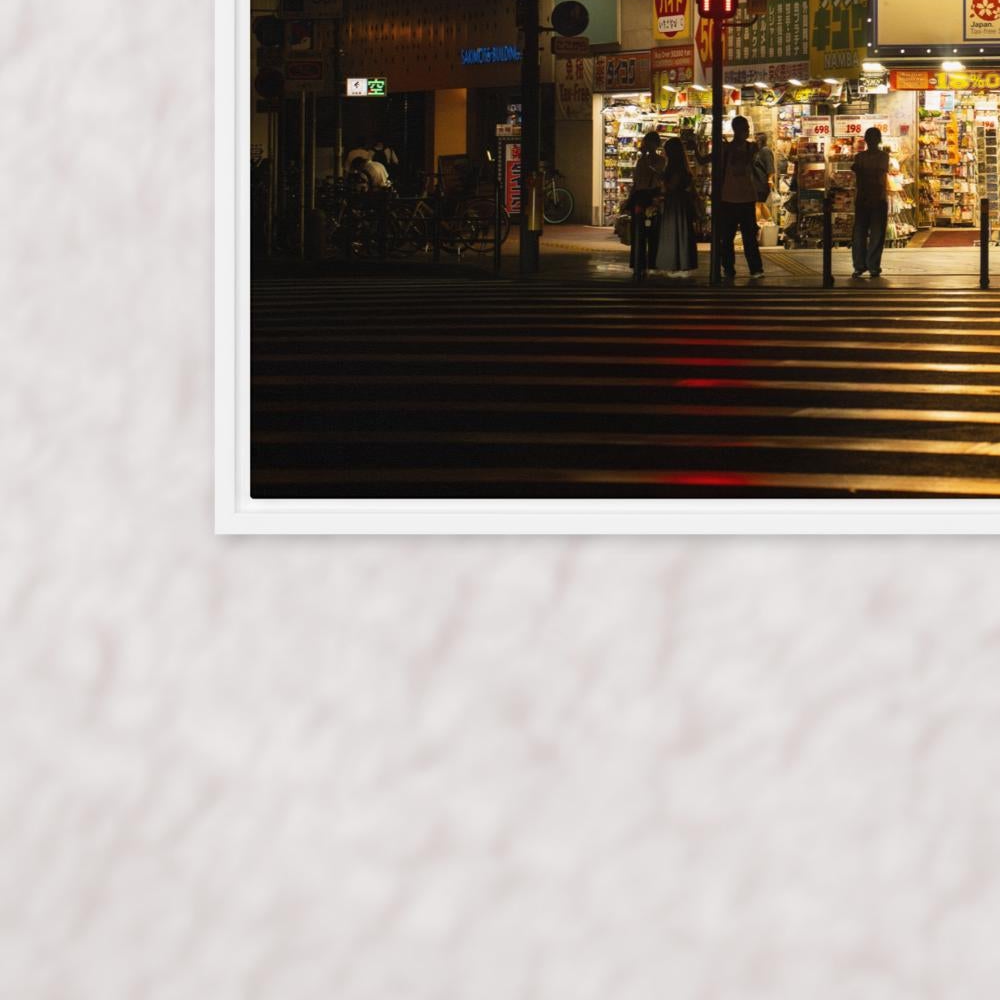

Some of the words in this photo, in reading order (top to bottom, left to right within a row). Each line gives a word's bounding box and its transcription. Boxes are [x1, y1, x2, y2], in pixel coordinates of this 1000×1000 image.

[824, 51, 860, 70] NAMBA
[814, 125, 830, 134] 698
[846, 124, 861, 133] 198
